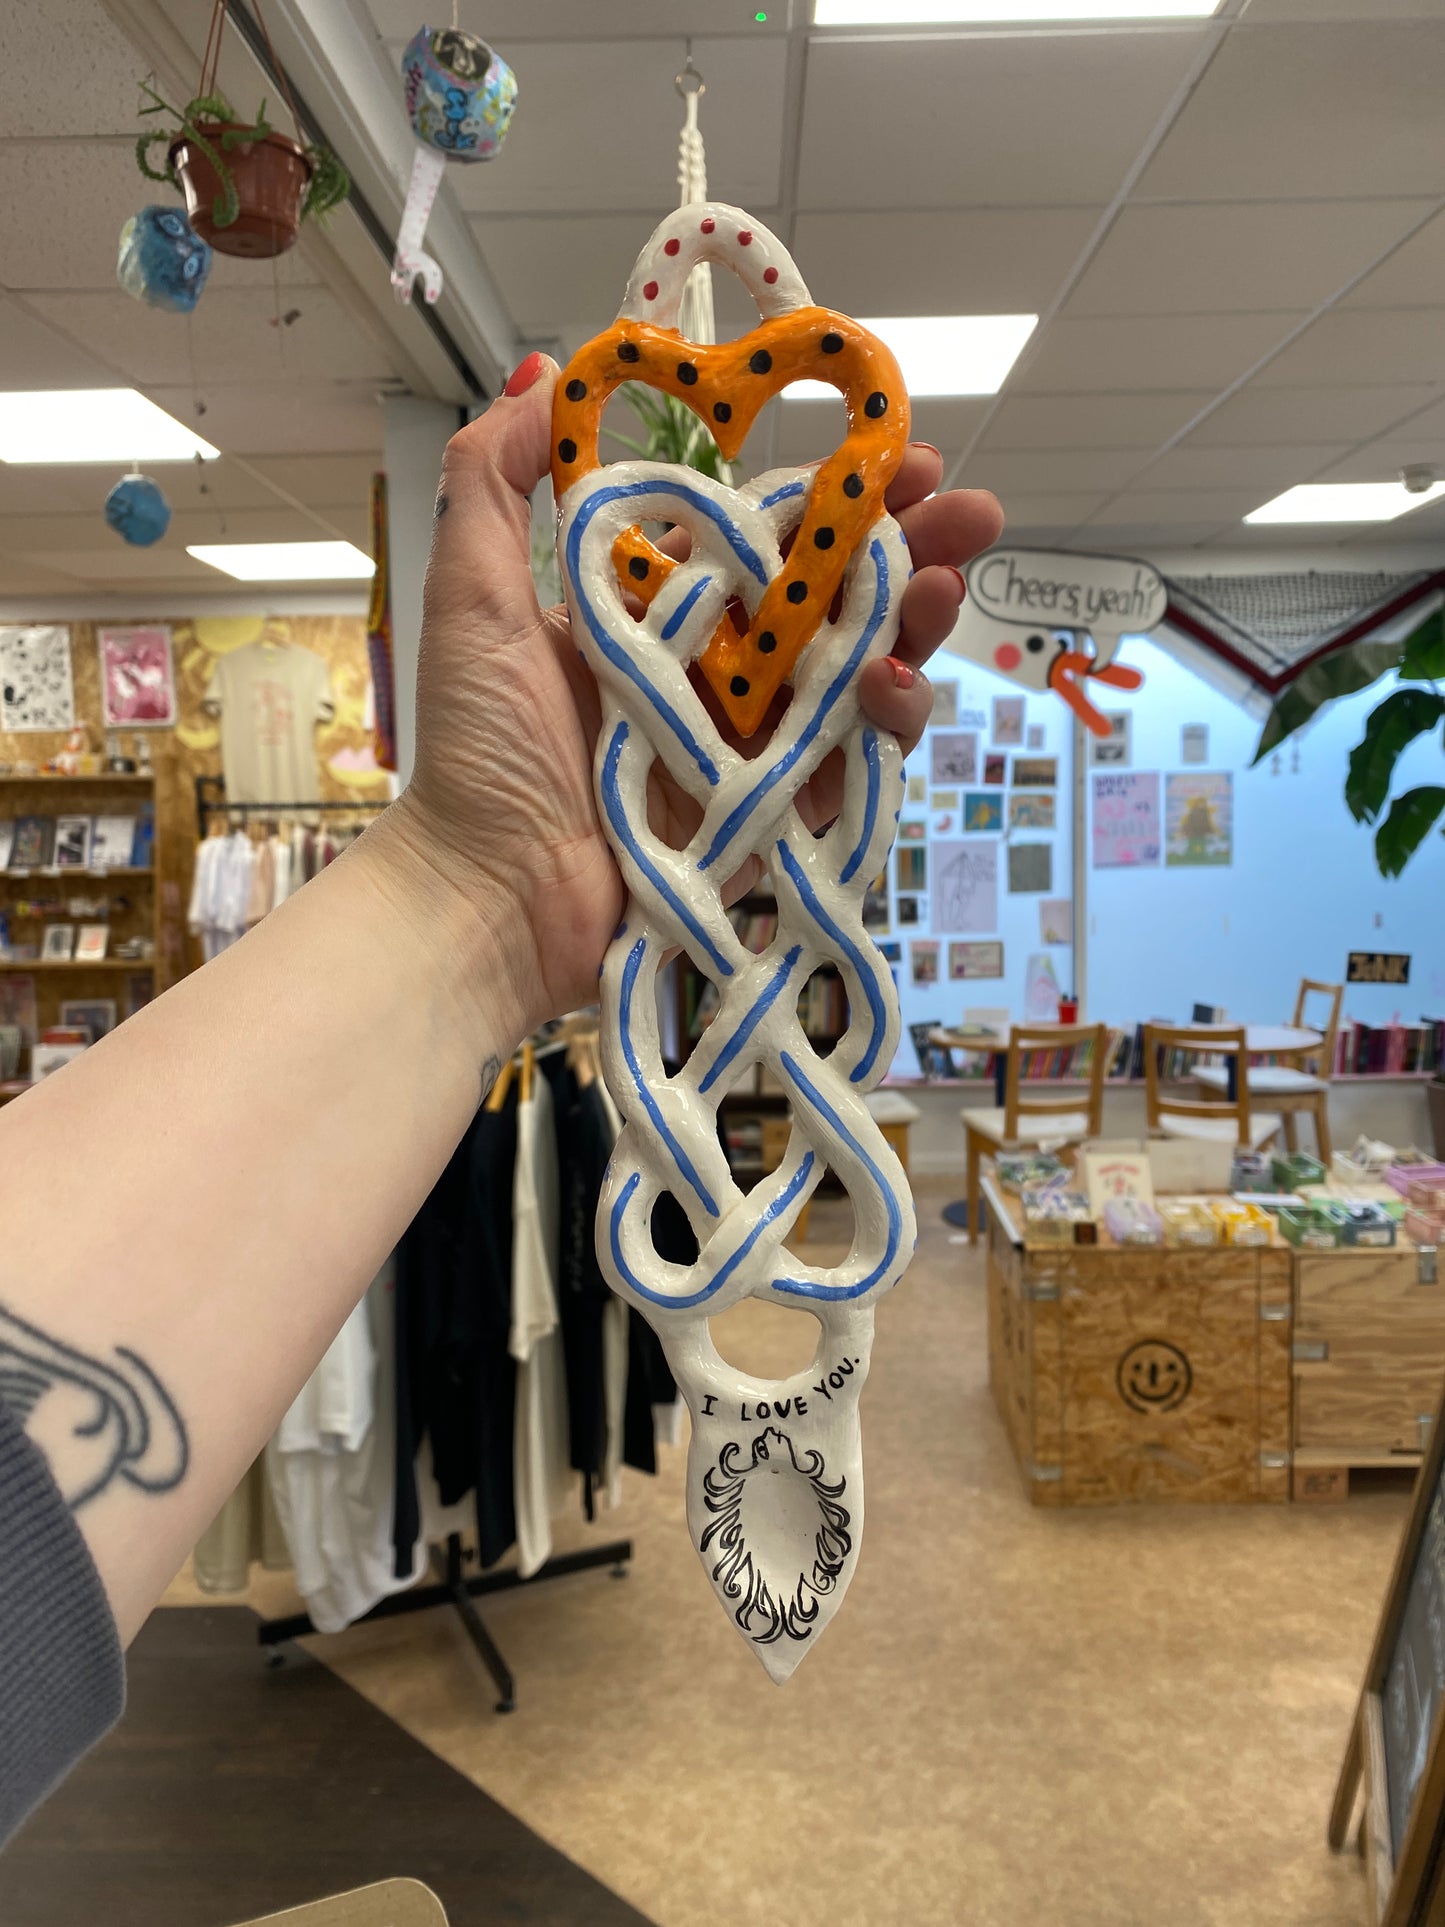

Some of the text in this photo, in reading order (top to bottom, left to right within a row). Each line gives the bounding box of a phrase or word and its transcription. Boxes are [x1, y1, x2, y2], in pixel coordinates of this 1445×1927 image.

[701, 1357, 860, 1421] I LOVE YOU.
